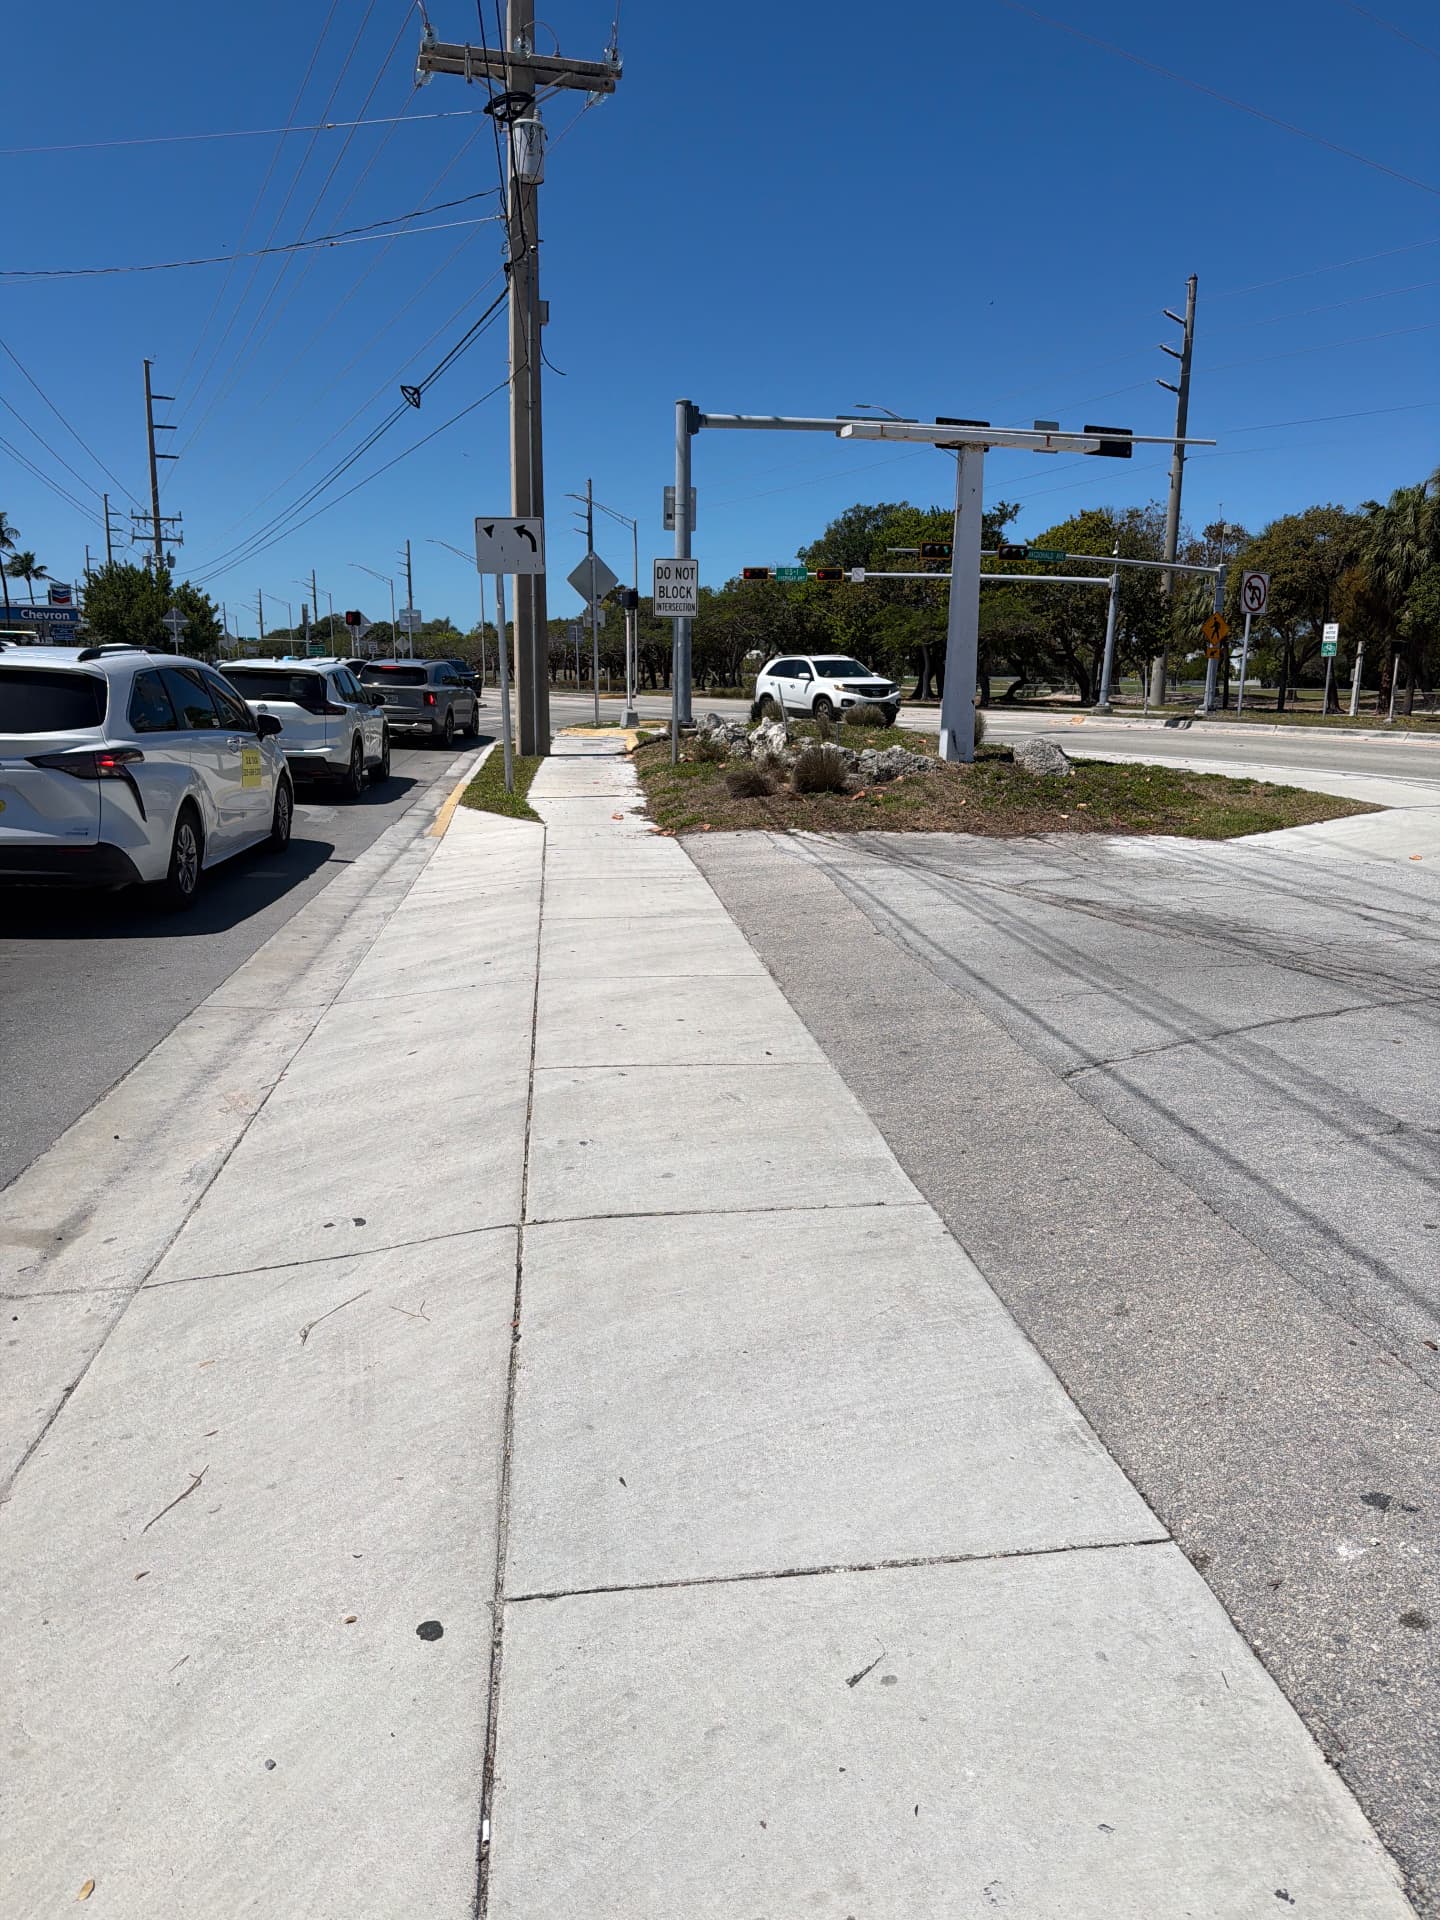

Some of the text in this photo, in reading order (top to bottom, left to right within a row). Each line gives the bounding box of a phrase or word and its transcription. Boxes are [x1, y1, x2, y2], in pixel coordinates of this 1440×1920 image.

[656, 566, 695, 580] DO NOT
[658, 585, 692, 599] BLOCK
[656, 602, 695, 612] INTERSECTION
[20, 609, 70, 620] Chevron
